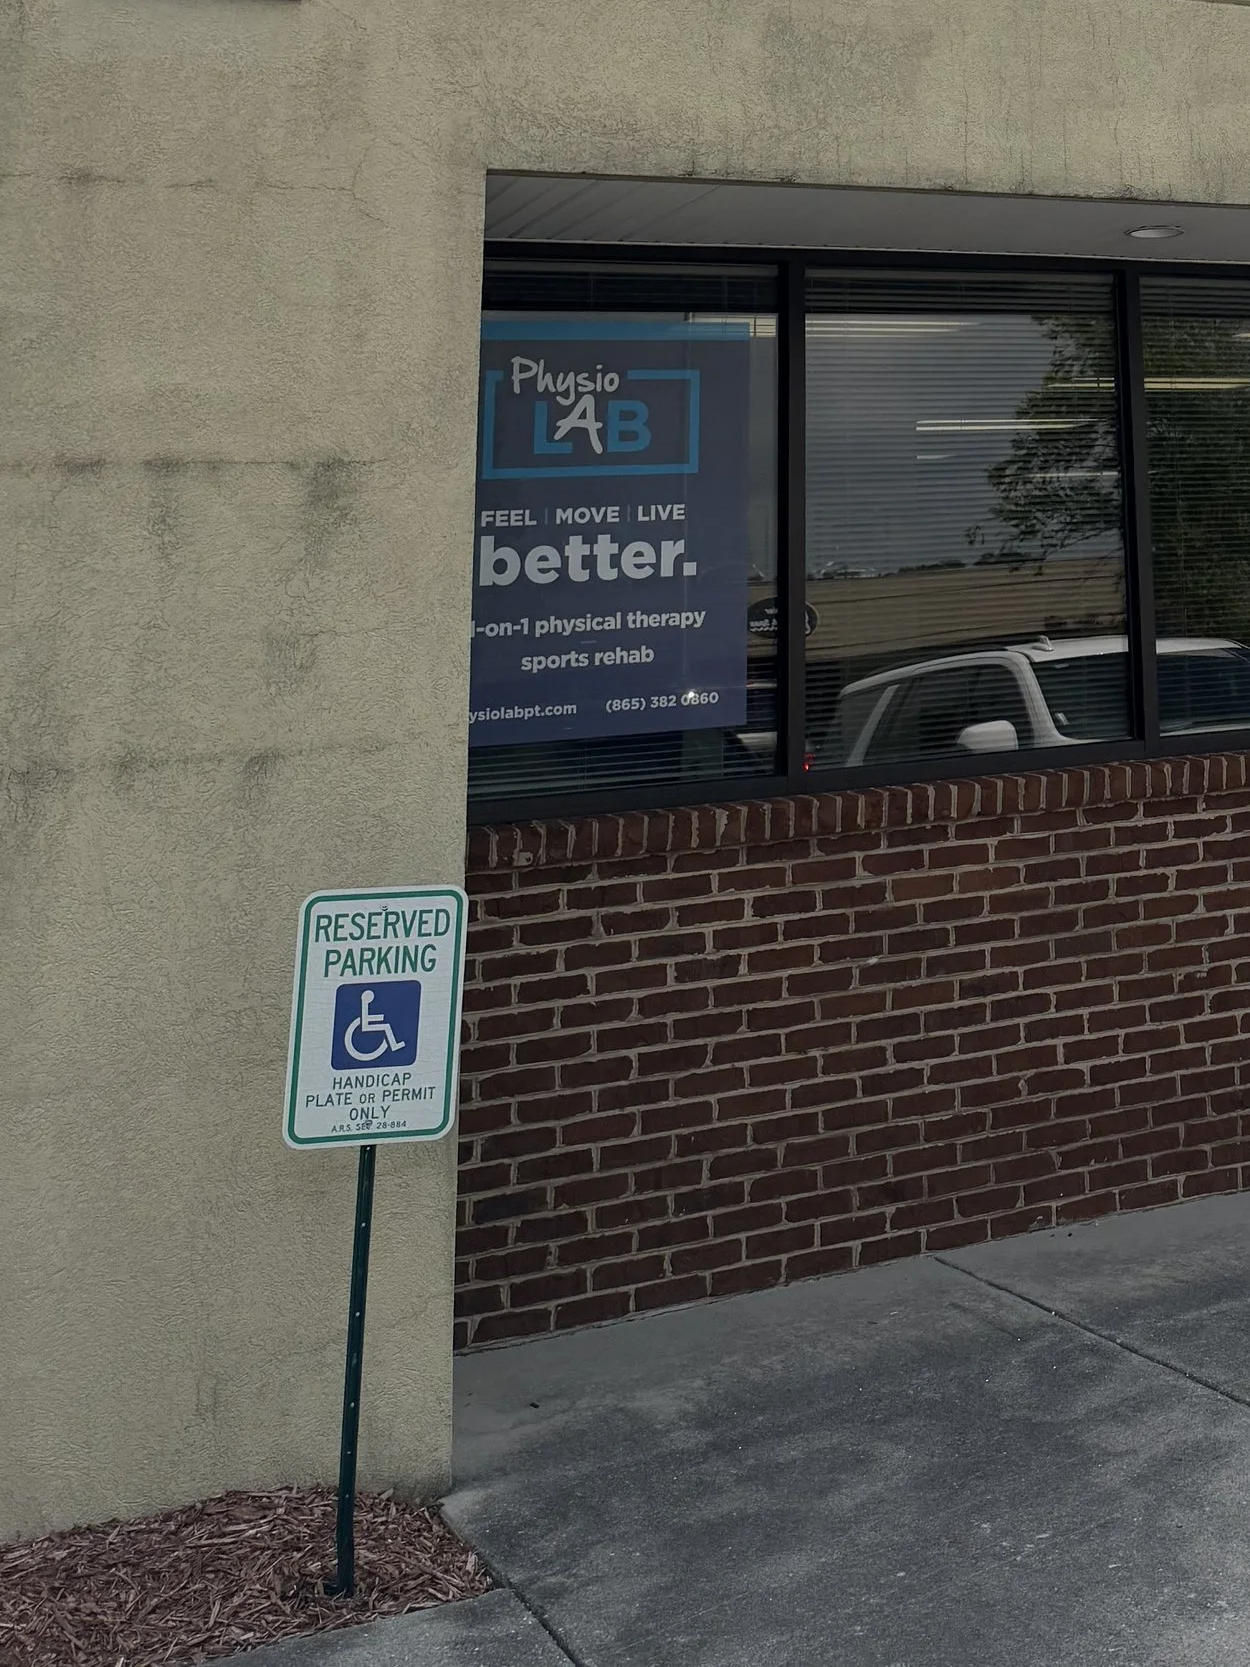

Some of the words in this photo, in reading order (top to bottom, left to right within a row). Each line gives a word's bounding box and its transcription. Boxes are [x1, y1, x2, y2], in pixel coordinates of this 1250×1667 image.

[510, 356, 619, 405] Physio
[534, 394, 651, 454] LAB
[481, 509, 537, 527] FEEL
[555, 506, 620, 525] MOVE
[637, 504, 686, 522] LIVE
[479, 534, 698, 587] better.
[535, 611, 622, 637] physical
[627, 610, 706, 629] therapy
[521, 650, 589, 673] sports
[594, 645, 655, 666] rehab
[605, 696, 646, 713] (865)
[650, 695, 677, 709] 382
[681, 691, 720, 706] 0860
[314, 908, 451, 942] RESERVED
[324, 944, 437, 977] PARKING
[332, 1072, 412, 1090] HANDICAP
[305, 1093, 352, 1108] PLATE
[359, 1093, 376, 1104] OR
[382, 1086, 436, 1102] PERMIT
[349, 1105, 391, 1120] ONLY
[376, 1120, 407, 1130] 28-884
